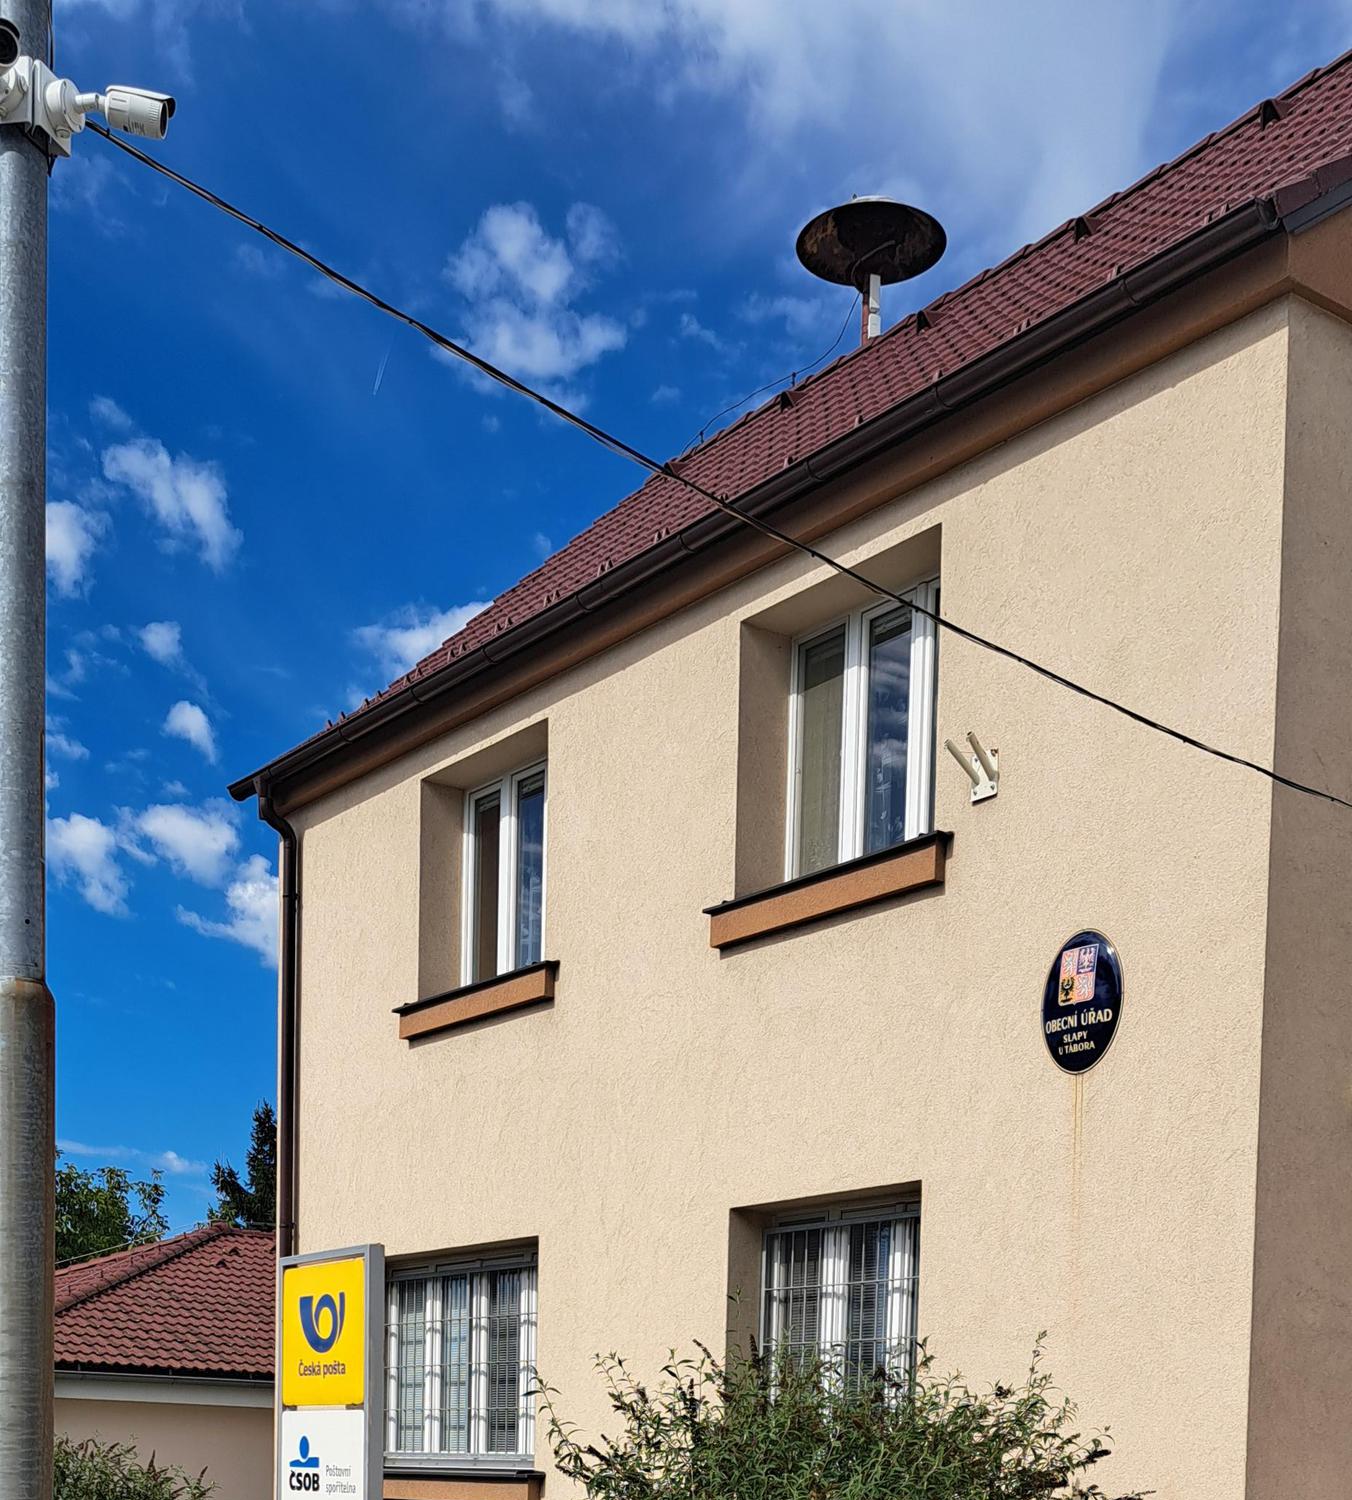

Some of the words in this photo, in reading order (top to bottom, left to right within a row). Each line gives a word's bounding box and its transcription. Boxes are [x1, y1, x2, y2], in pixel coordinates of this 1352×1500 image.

[1045, 1010, 1078, 1034] OBECNÍ
[1081, 1007, 1113, 1026] ÚŘAD
[1063, 1030, 1088, 1043] SLAPY
[1058, 1046, 1064, 1056] U
[1064, 1040, 1096, 1054] TÁBORA
[298, 1359, 321, 1377] Česká
[322, 1360, 346, 1379] pošta
[289, 1469, 320, 1491] ČSOB
[325, 1480, 357, 1496] spořitelna
